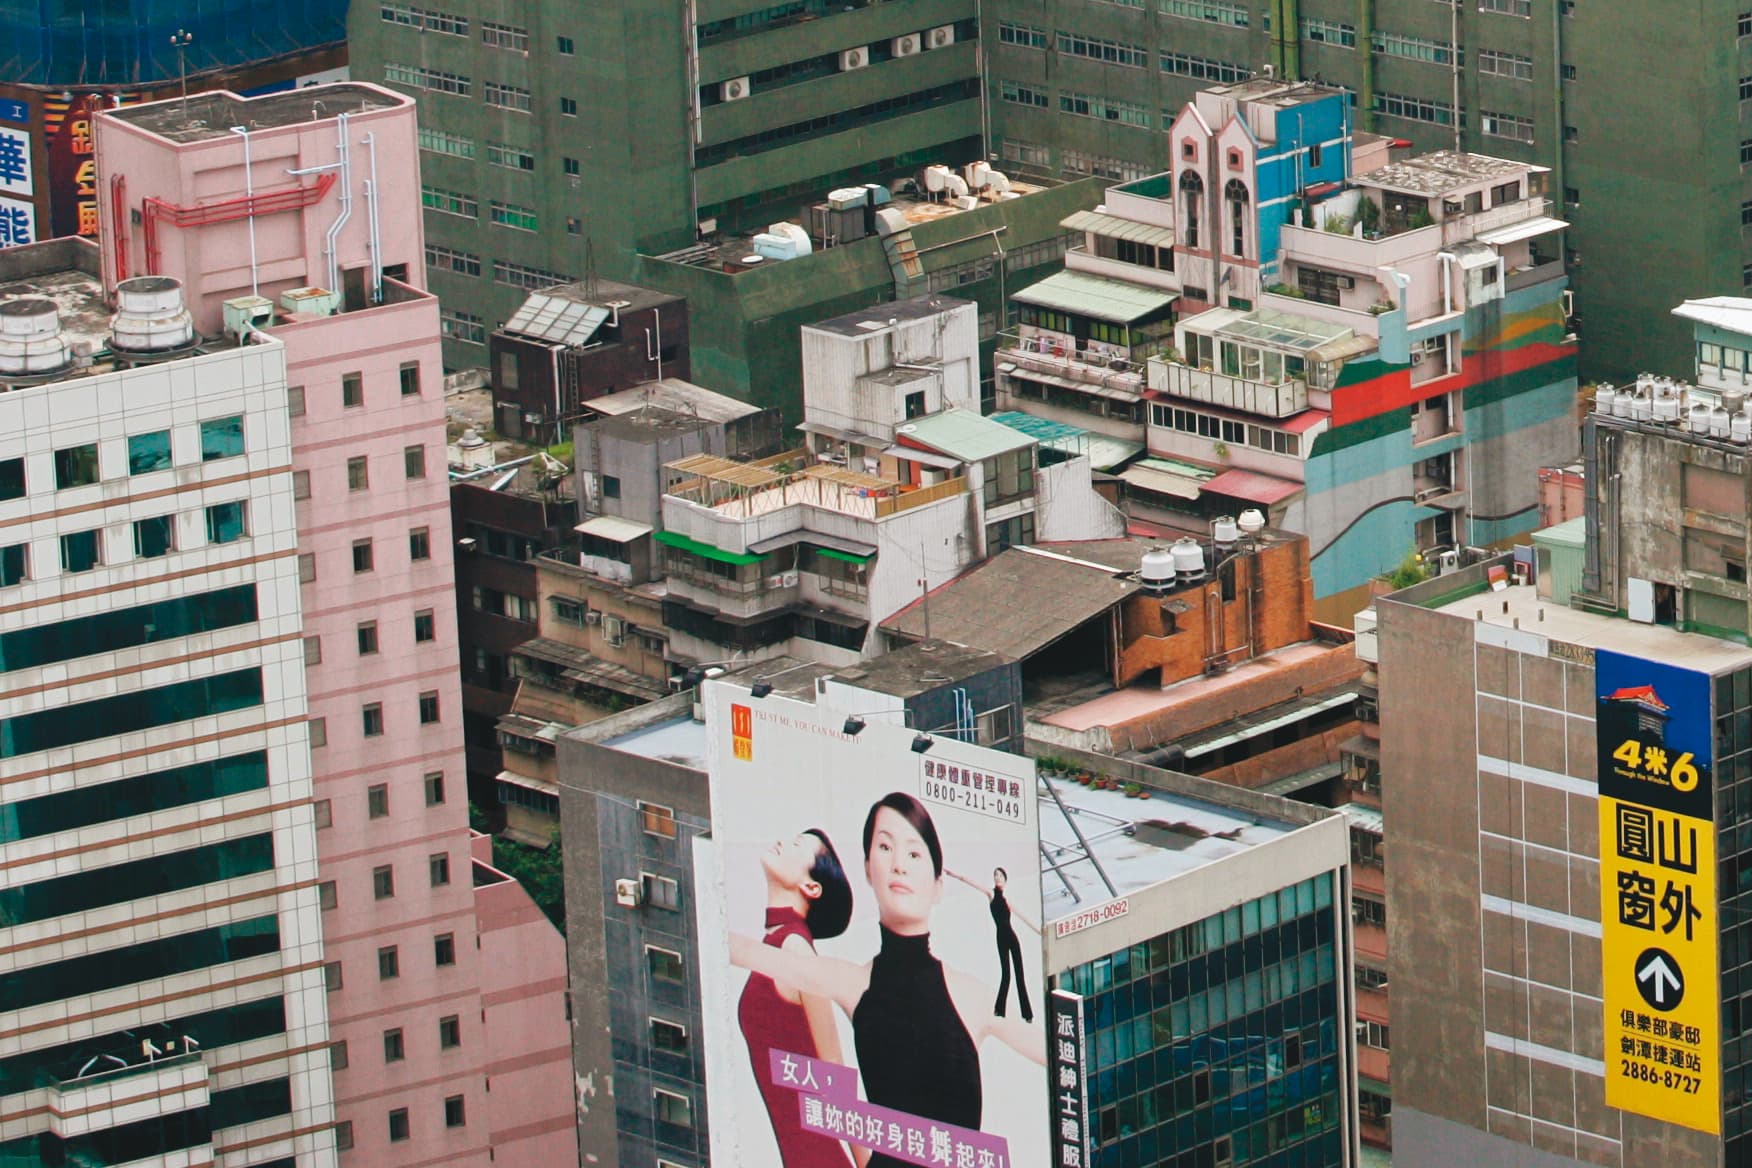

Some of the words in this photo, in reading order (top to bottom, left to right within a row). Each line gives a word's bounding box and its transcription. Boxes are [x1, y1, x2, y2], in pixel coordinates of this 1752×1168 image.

[755, 710, 778, 721] TRUST
[794, 719, 809, 731] YOU
[812, 723, 827, 736] CAN
[925, 760, 1020, 798] 健康體重管理專線
[926, 781, 1019, 818] 0800-211-049
[1616, 802, 1698, 875] 圓山
[1617, 870, 1702, 941] 窗外
[1620, 1008, 1701, 1045] 俱樂部豪邸
[1620, 1035, 1701, 1073] 劍潭捷運站
[1057, 1013, 1081, 1168] 派迪紳士禮服
[1621, 1059, 1701, 1095] 2886-8727
